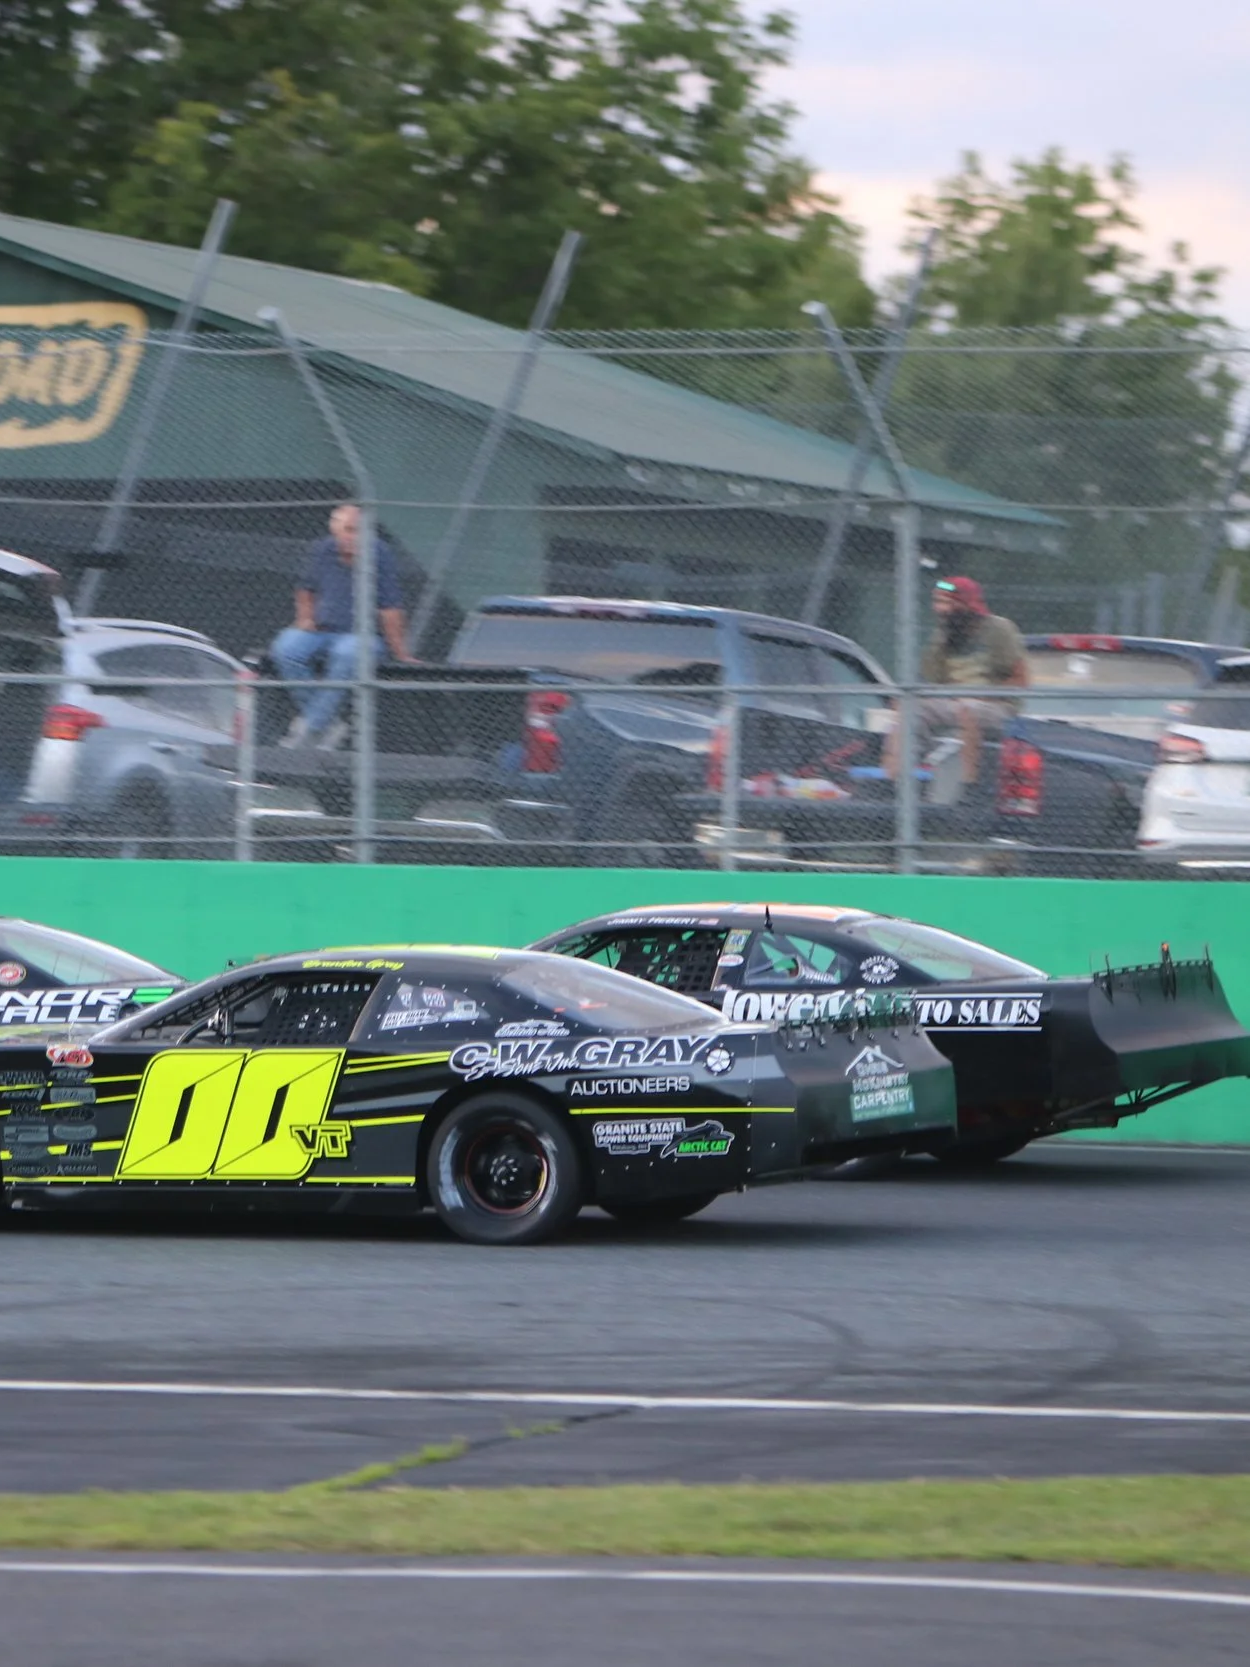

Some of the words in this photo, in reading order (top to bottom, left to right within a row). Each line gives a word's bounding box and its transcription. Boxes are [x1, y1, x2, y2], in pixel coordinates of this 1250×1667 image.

[957, 999, 1042, 1024] SALES
[574, 1034, 720, 1069] GRAY
[570, 1075, 691, 1097] AUCTIONEERS
[114, 1048, 347, 1181] 00
[290, 1121, 352, 1158] VT
[595, 1123, 648, 1137] GRANITE
[649, 1121, 683, 1134] STATE
[677, 1140, 710, 1153] ARCTIC
[710, 1139, 729, 1151] CAT
